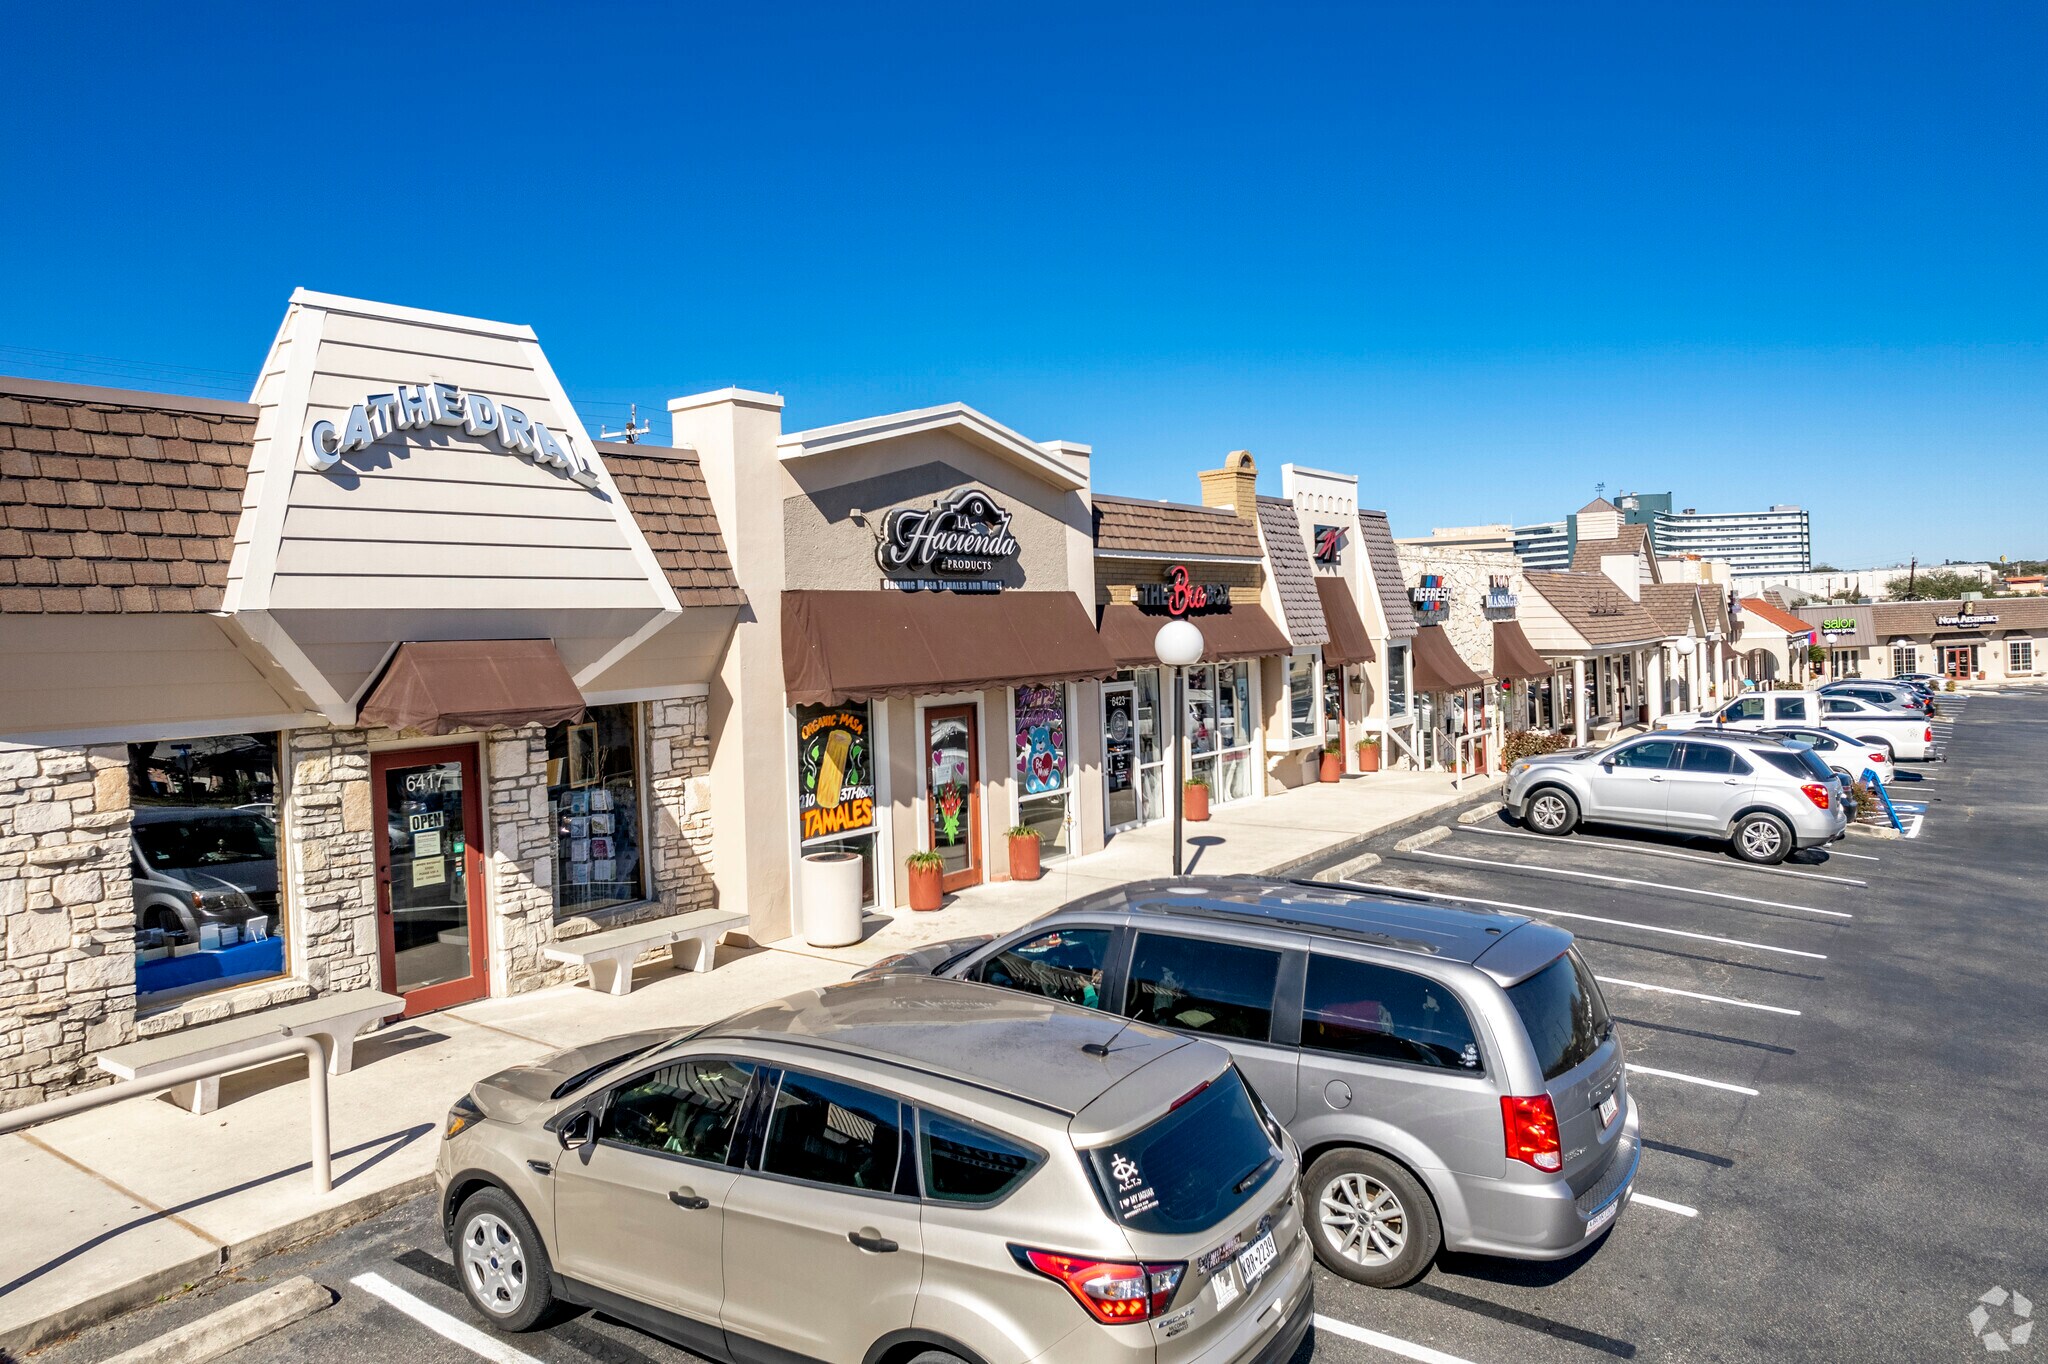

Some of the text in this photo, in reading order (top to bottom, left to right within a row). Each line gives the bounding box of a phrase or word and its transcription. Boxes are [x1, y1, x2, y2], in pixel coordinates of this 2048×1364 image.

[303, 381, 600, 488] CATHEDRAL
[957, 516, 971, 530] LA
[890, 510, 1017, 564] Hacienda
[946, 559, 992, 571] PRODUCTS
[883, 579, 916, 591] ORGANIC
[1143, 583, 1169, 606] THE
[1413, 587, 1452, 602] REFRESH
[1487, 594, 1518, 609] MASSAGE
[1823, 616, 1857, 629] salon
[1112, 695, 1126, 707] 6423
[801, 713, 863, 740] ORGANIC MASA
[406, 771, 444, 792] 6417
[800, 793, 815, 809] 210
[412, 811, 442, 831] OPEN
[801, 798, 873, 839] TAMALES
